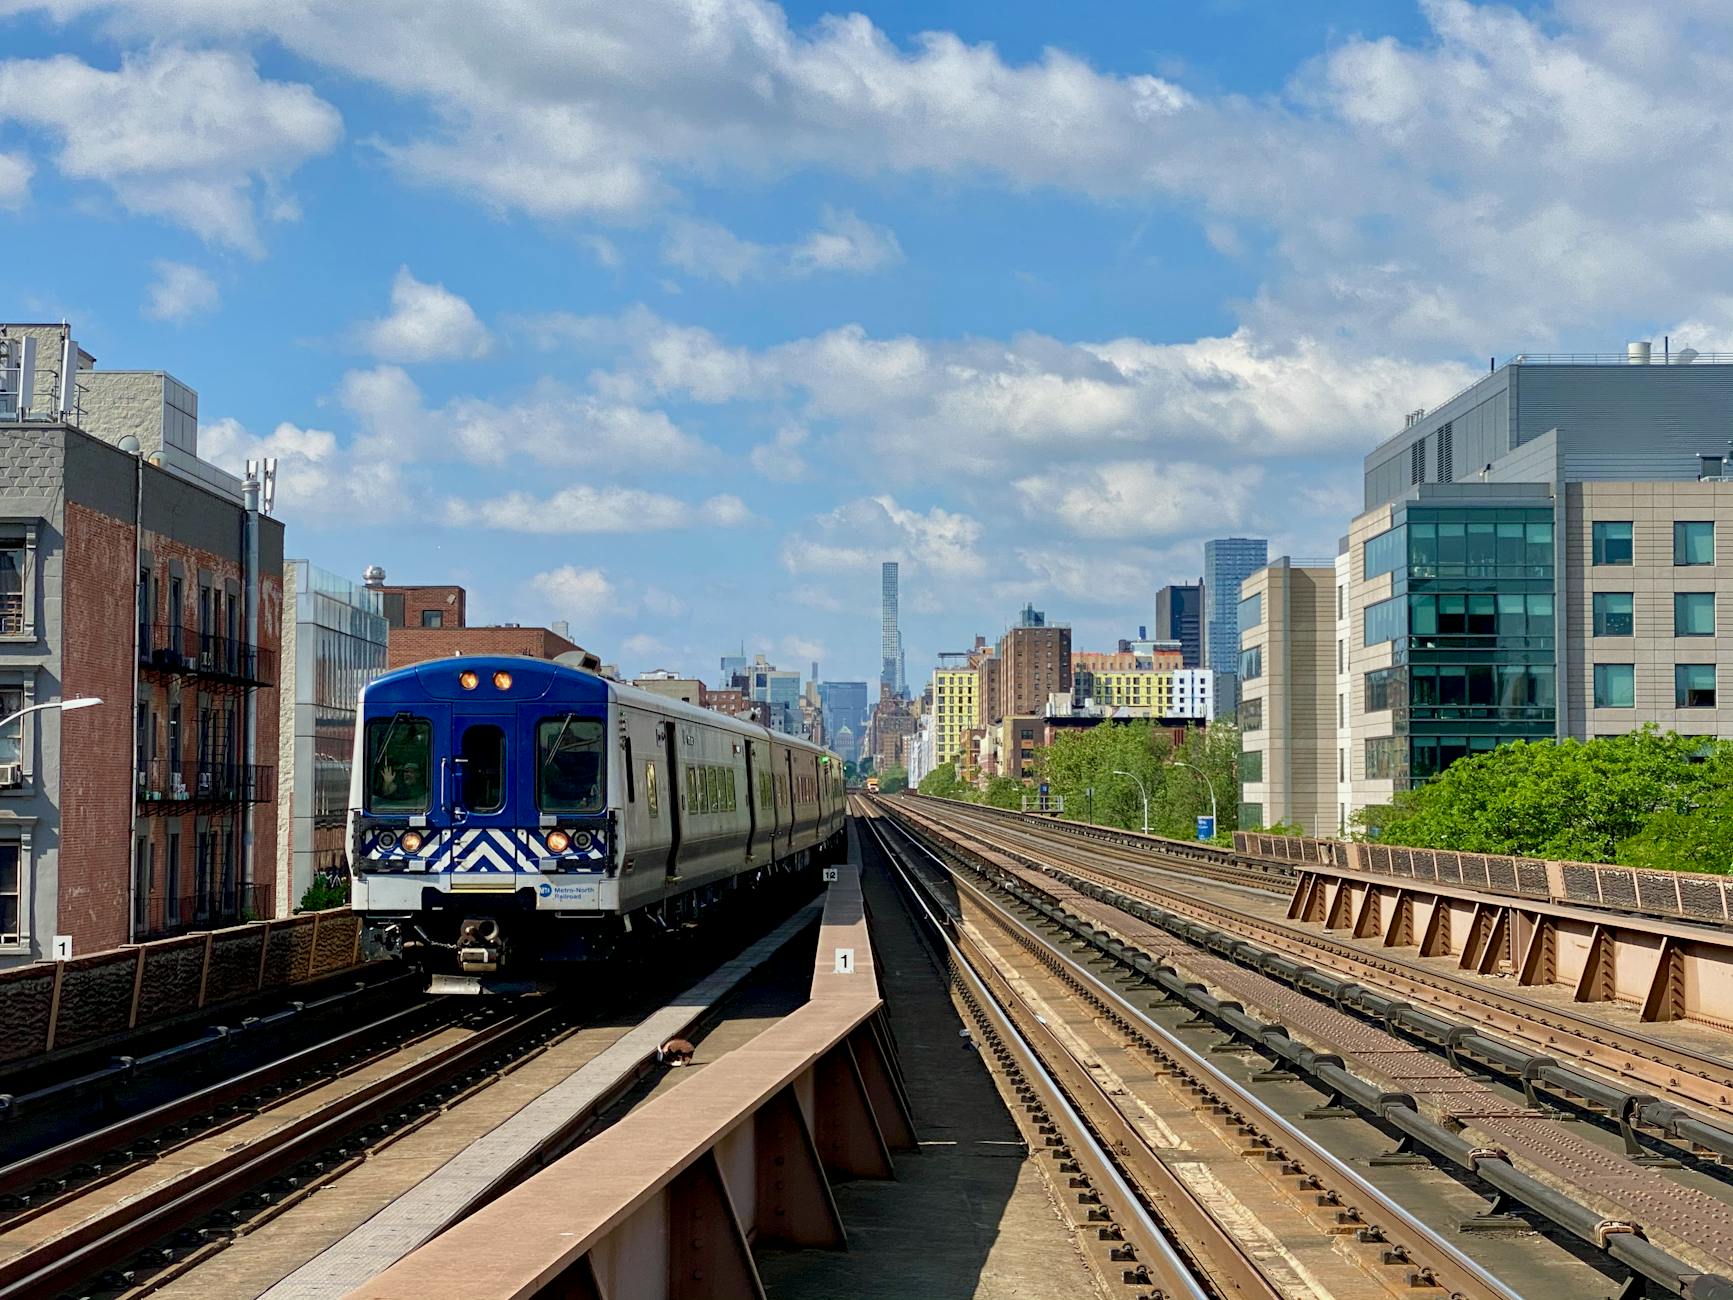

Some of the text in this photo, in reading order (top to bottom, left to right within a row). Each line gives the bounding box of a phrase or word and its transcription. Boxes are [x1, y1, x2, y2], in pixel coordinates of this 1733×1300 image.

[825, 871, 836, 879] 12
[58, 941, 66, 956] 1
[840, 954, 848, 969] 1
